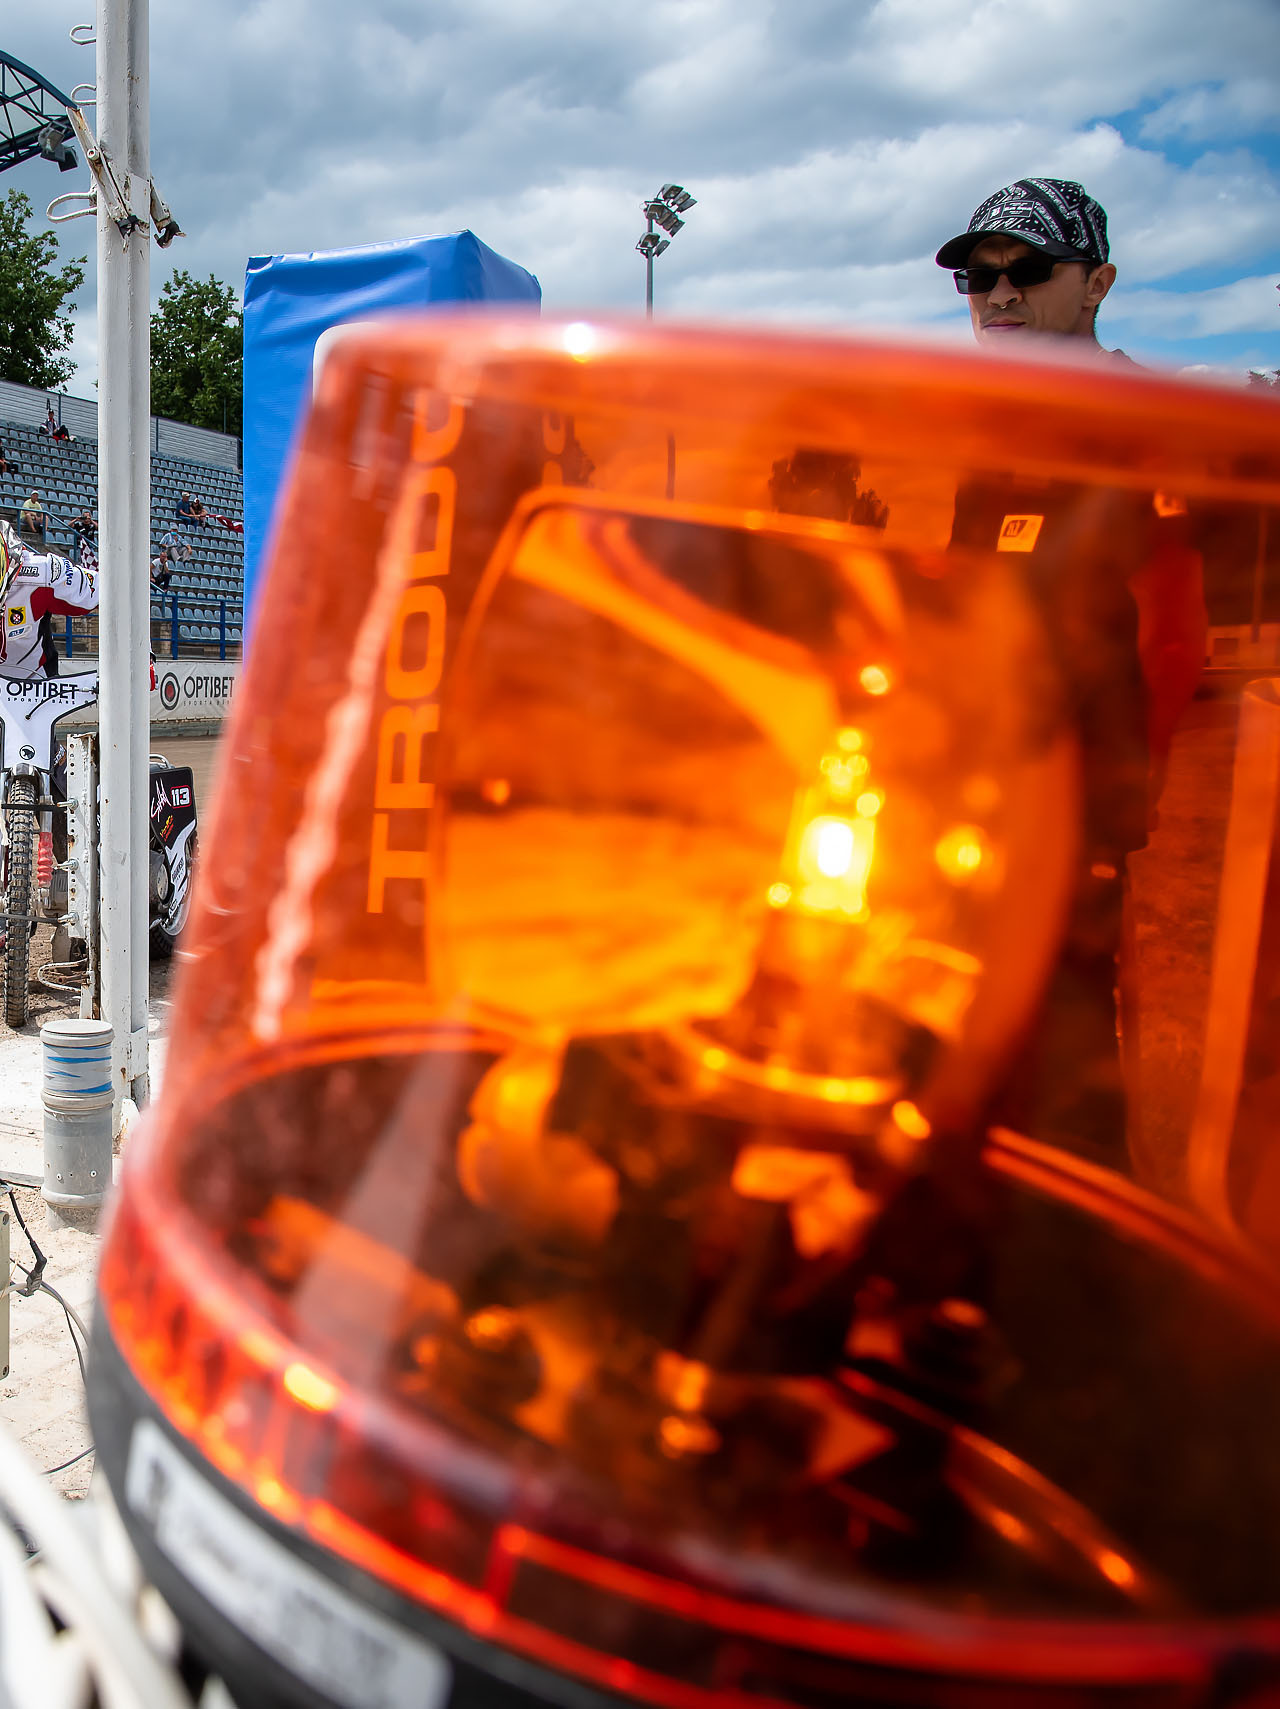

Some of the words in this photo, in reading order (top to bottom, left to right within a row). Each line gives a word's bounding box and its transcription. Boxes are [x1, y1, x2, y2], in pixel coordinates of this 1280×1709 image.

[6, 681, 78, 699] OPTIBET
[184, 676, 234, 698] OPTIBET
[171, 787, 190, 806] 113
